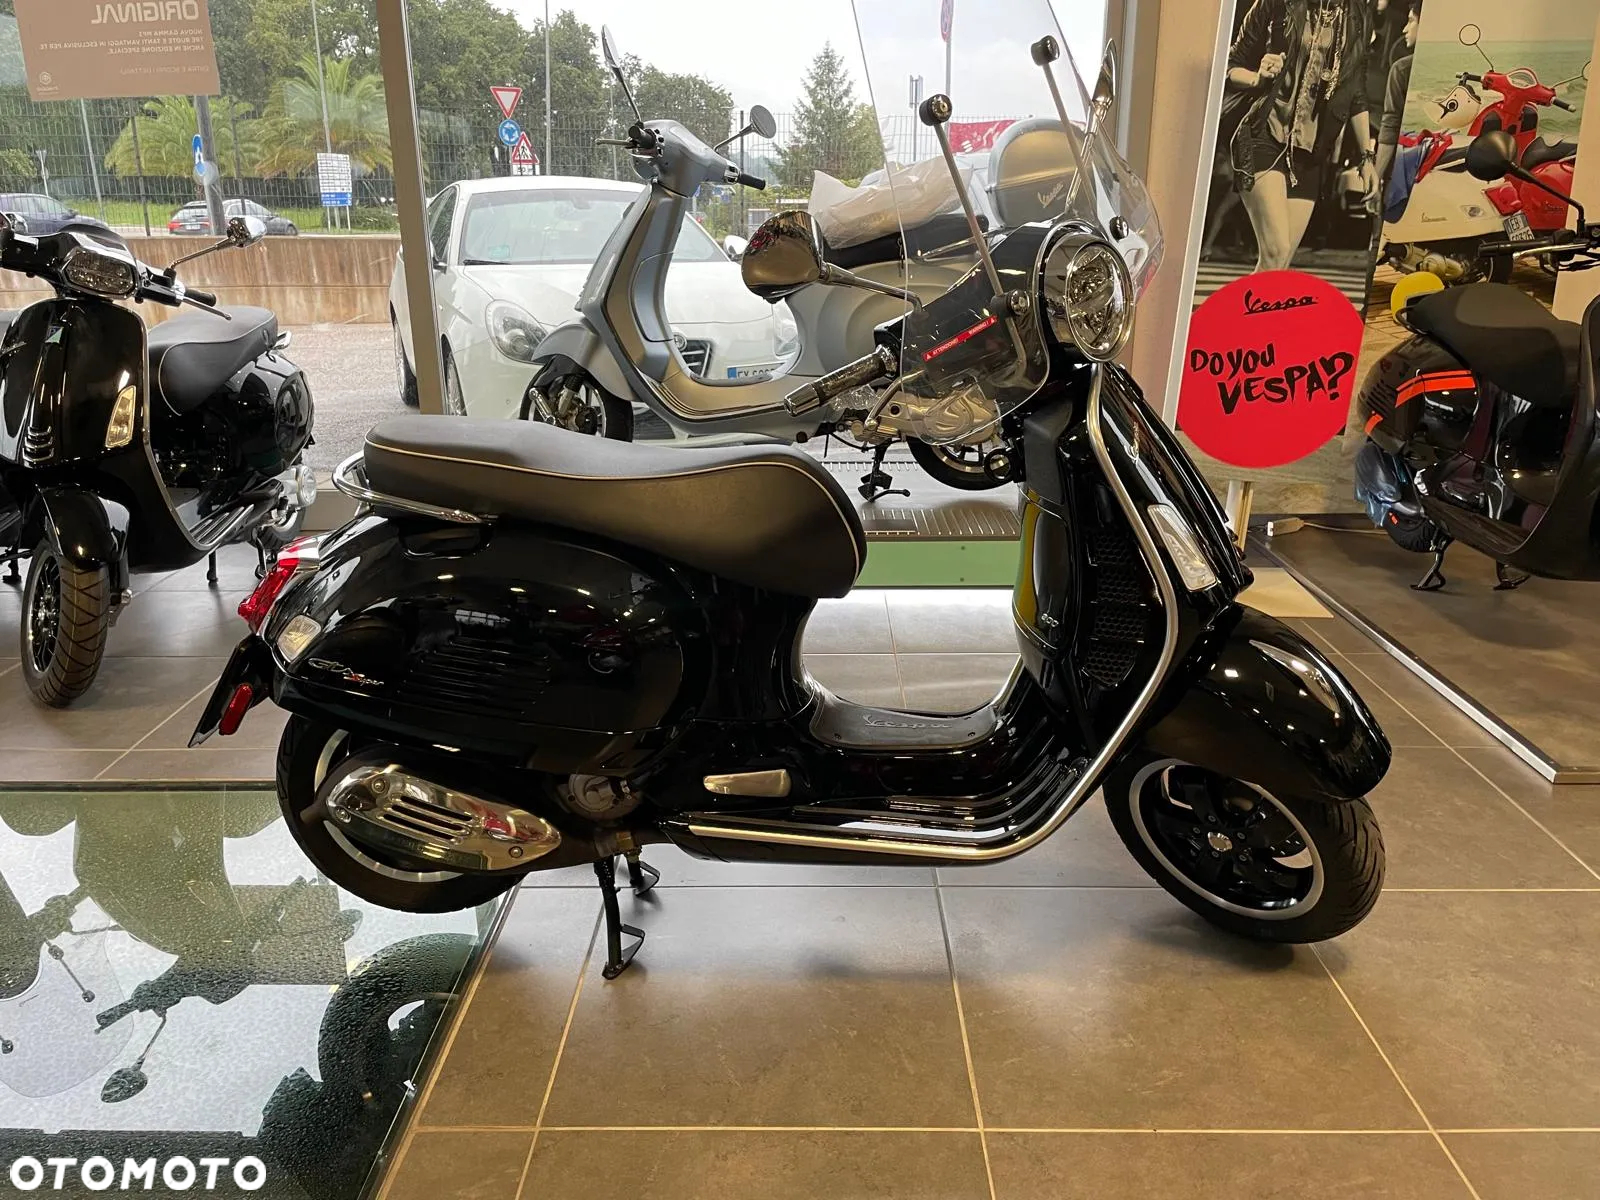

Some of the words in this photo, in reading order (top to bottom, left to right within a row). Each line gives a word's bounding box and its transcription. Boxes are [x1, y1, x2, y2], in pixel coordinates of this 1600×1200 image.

[1244, 289, 1318, 315] Vespa
[1217, 351, 1354, 415] VESPA?
[862, 714, 953, 730] Vespa
